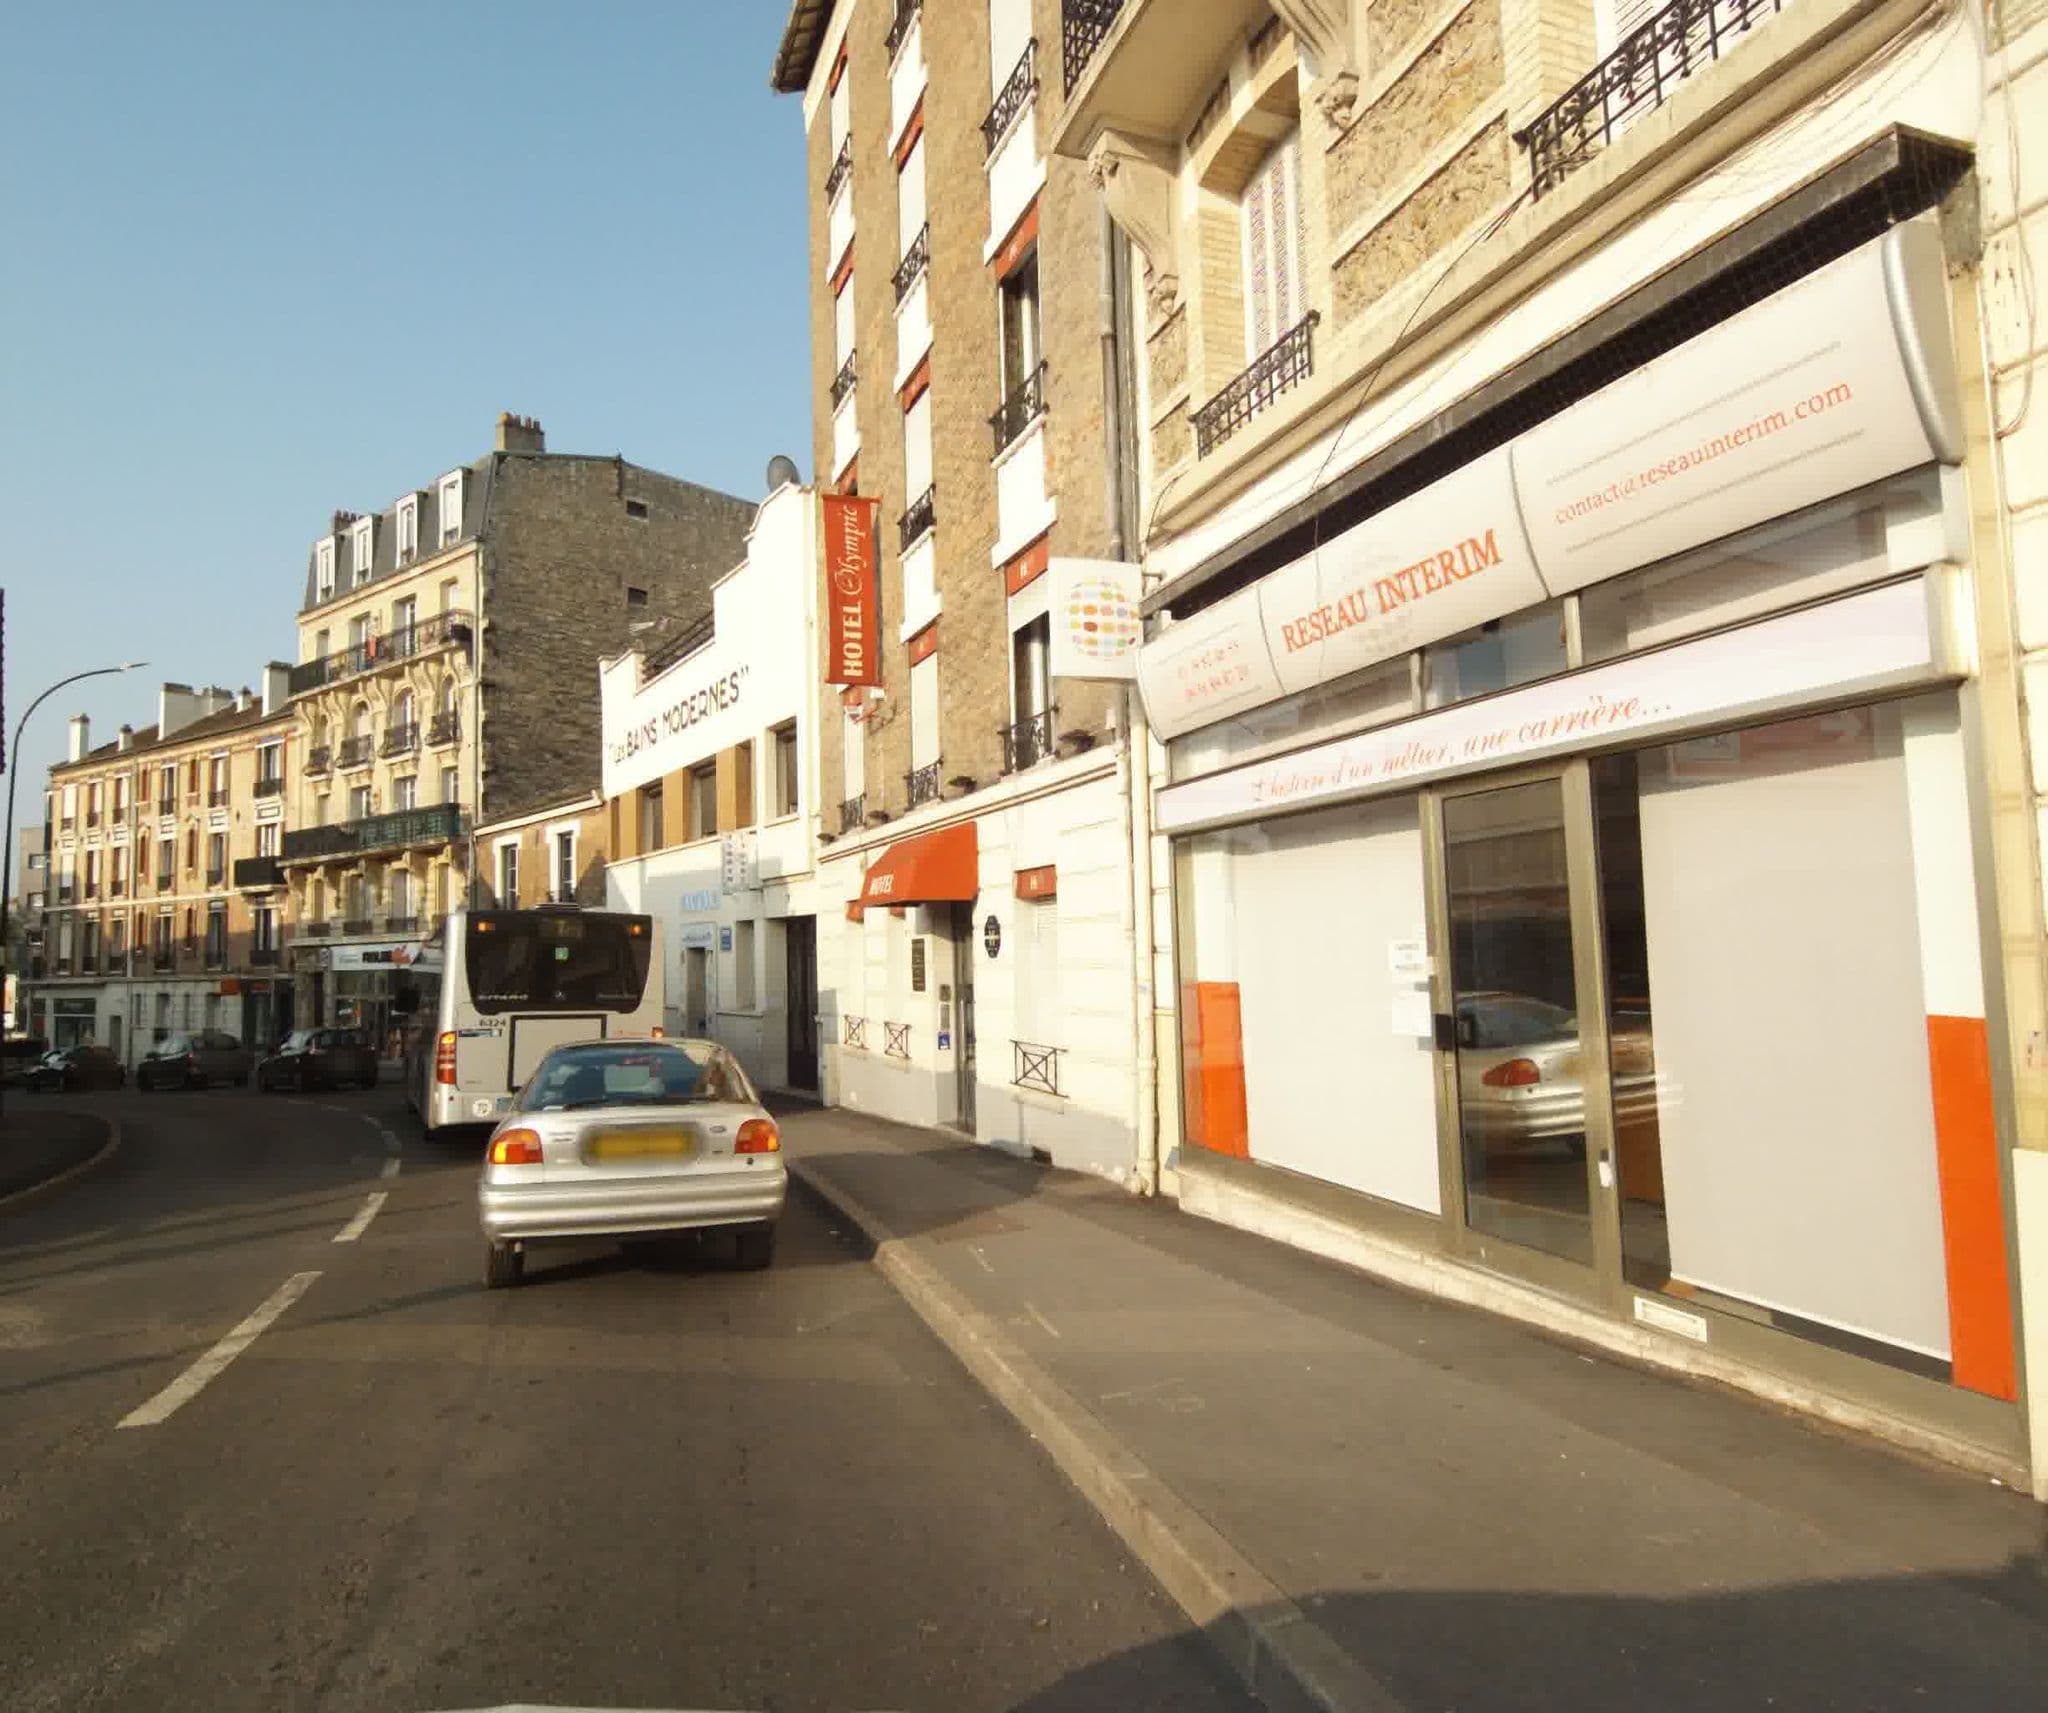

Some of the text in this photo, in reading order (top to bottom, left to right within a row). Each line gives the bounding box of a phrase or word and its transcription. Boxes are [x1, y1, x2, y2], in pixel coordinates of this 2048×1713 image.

[834, 504, 868, 678] HOTEL Olympic
[1281, 586, 1369, 653] RESEAU
[1371, 527, 1504, 614] INTERIM
[626, 715, 658, 758] BAINS
[869, 873, 896, 897] HOTEL
